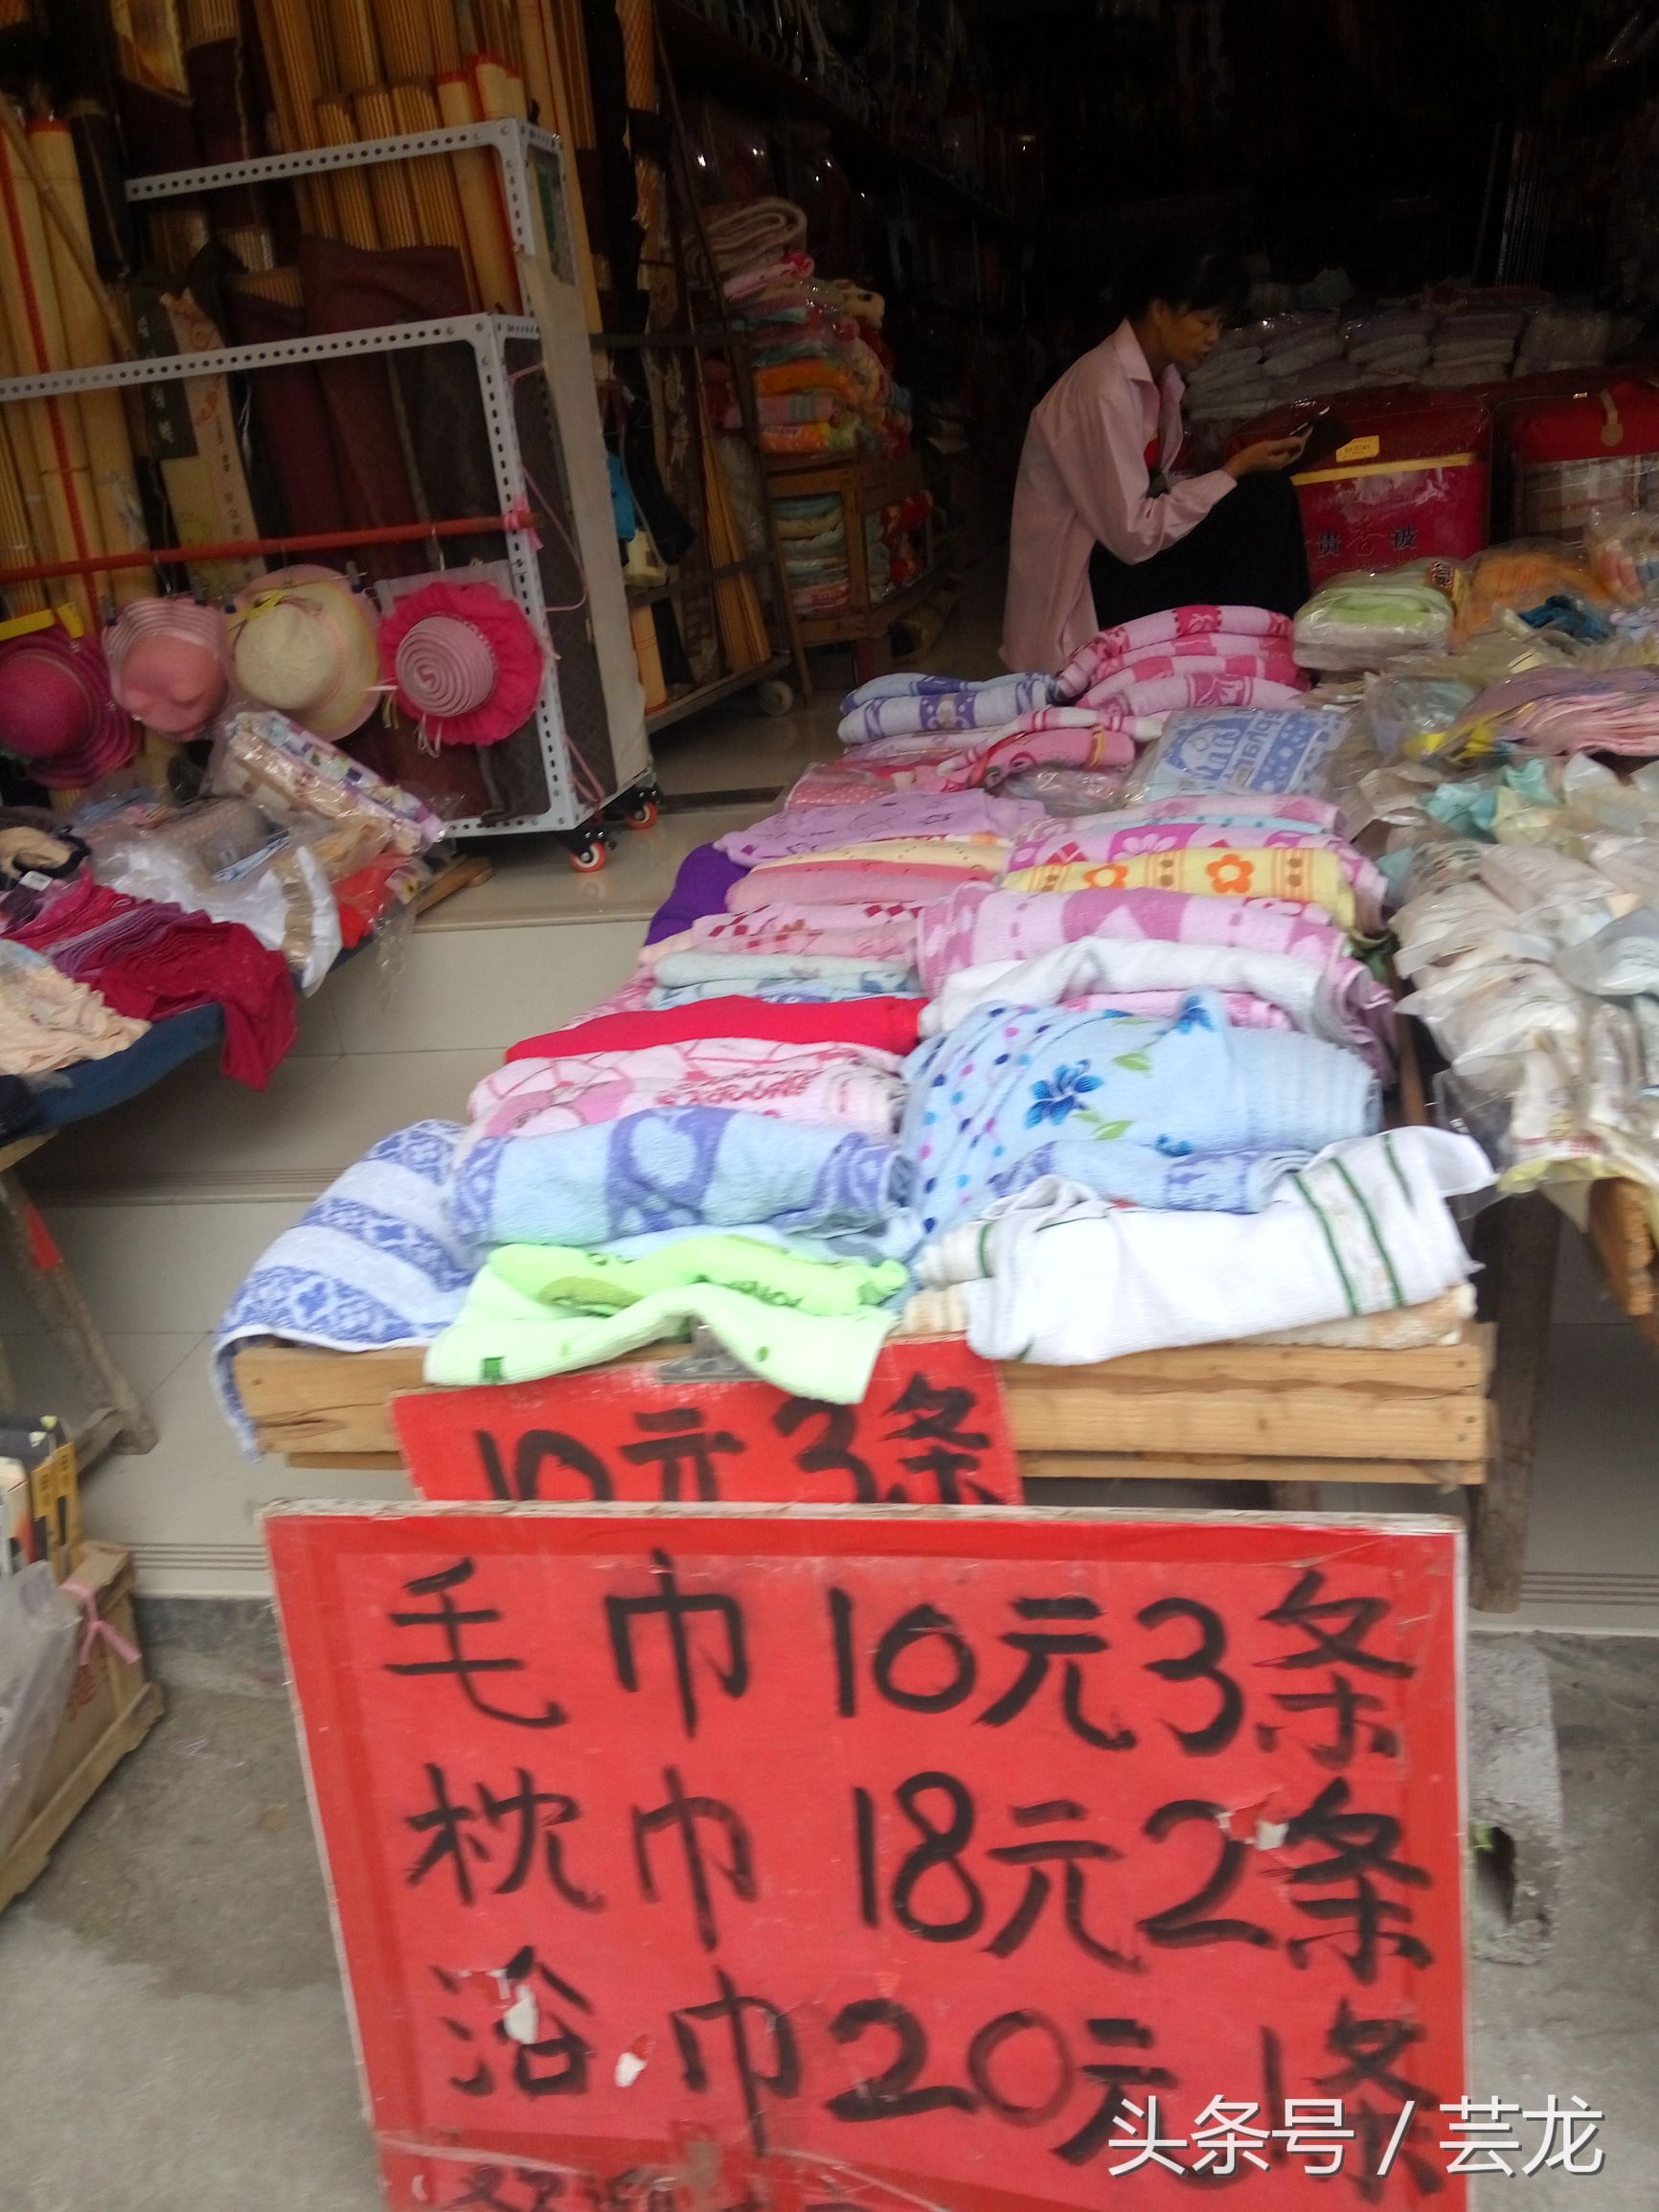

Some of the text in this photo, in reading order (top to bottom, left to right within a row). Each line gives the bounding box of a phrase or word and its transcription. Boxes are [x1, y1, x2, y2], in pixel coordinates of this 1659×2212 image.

[473, 1372, 1006, 1503] 10元3条
[384, 1548, 1418, 1768] 毛巾 10元3条
[405, 1763, 1434, 1985] 枕巾 18元2条
[429, 1945, 1444, 2203] 浴巾 20元1条
